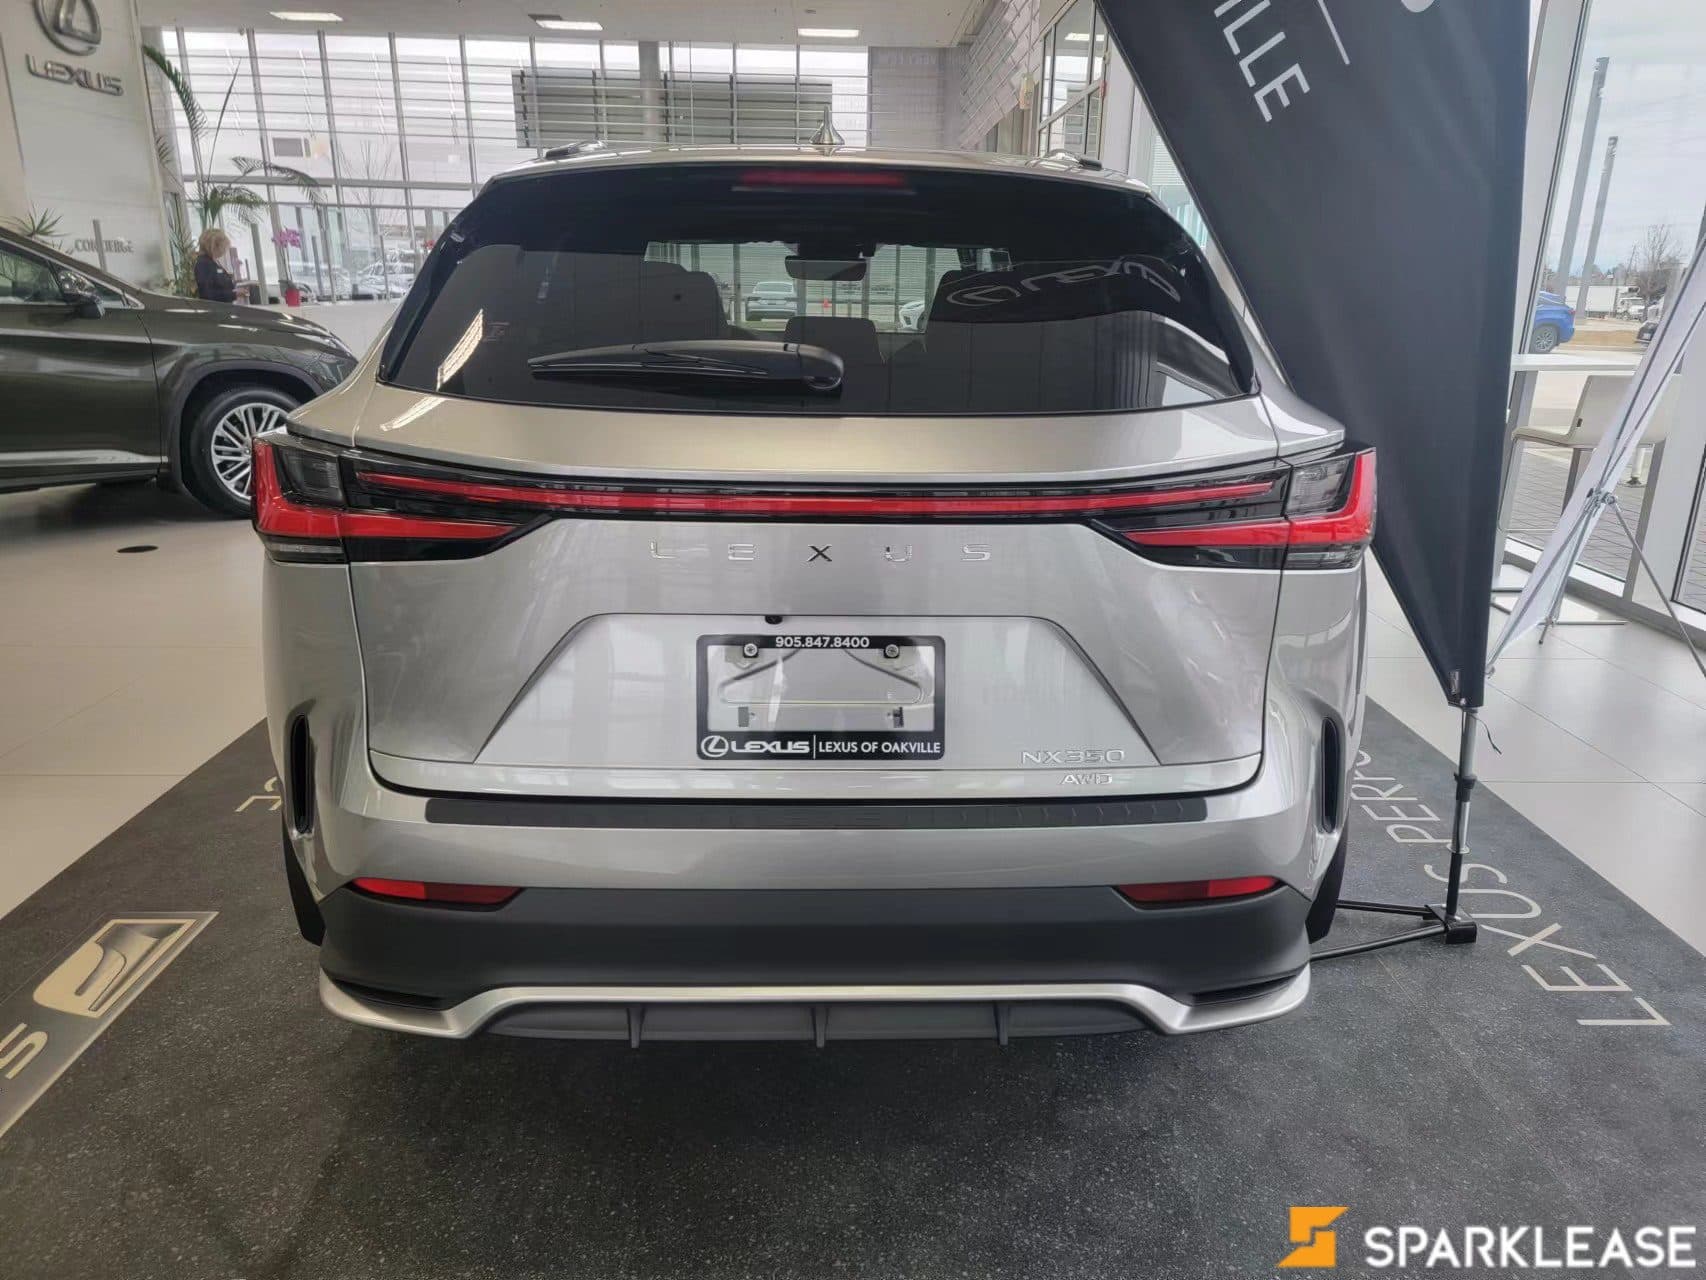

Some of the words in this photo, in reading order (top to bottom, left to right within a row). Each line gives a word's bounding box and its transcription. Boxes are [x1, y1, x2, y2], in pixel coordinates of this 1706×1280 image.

[25, 53, 125, 97] LEXUS
[74, 238, 134, 253] CONIERGE
[649, 543, 992, 562] LEXUS
[775, 636, 870, 648] 905.847.8400
[731, 740, 810, 754] LEXUS
[818, 741, 858, 753] LEXUS
[861, 741, 878, 753] OF
[881, 741, 941, 753] OAKVILLE
[1060, 772, 1113, 785] AWD
[1423, 862, 1672, 1026] LEXUS
